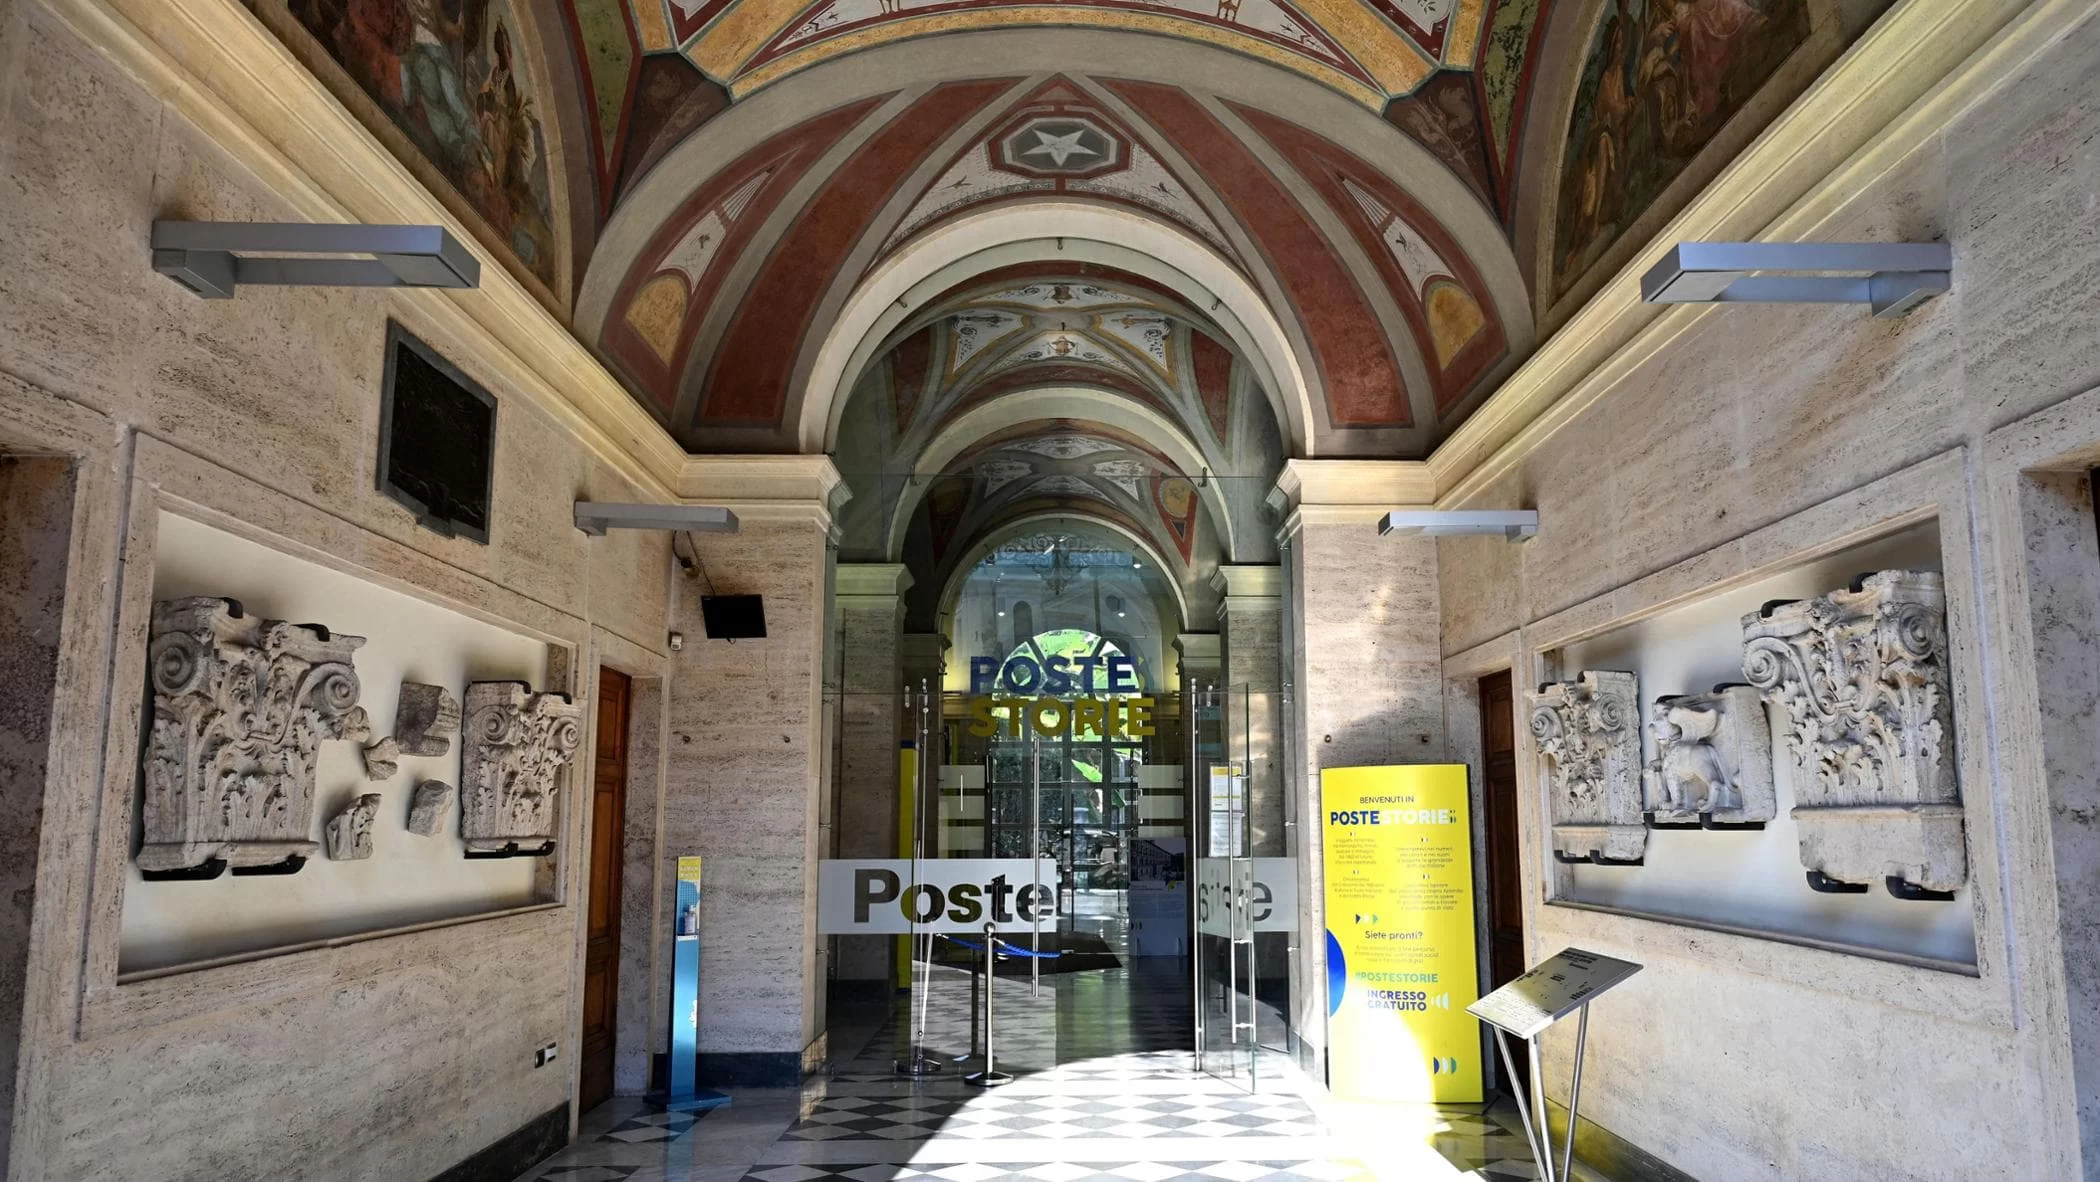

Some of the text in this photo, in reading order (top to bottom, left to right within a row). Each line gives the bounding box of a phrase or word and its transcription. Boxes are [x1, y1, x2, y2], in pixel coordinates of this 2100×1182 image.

[970, 656, 1137, 693] POSTE
[968, 697, 1156, 737] STORIE
[1360, 796, 1404, 804] BENVENUTI
[1330, 809, 1450, 826] POSTESTORIE
[854, 868, 1055, 923] Poste
[1365, 930, 1423, 941] Siete pronti?
[1367, 990, 1427, 1001] INGRESSO
[1367, 1000, 1427, 1012] GRATUITO
